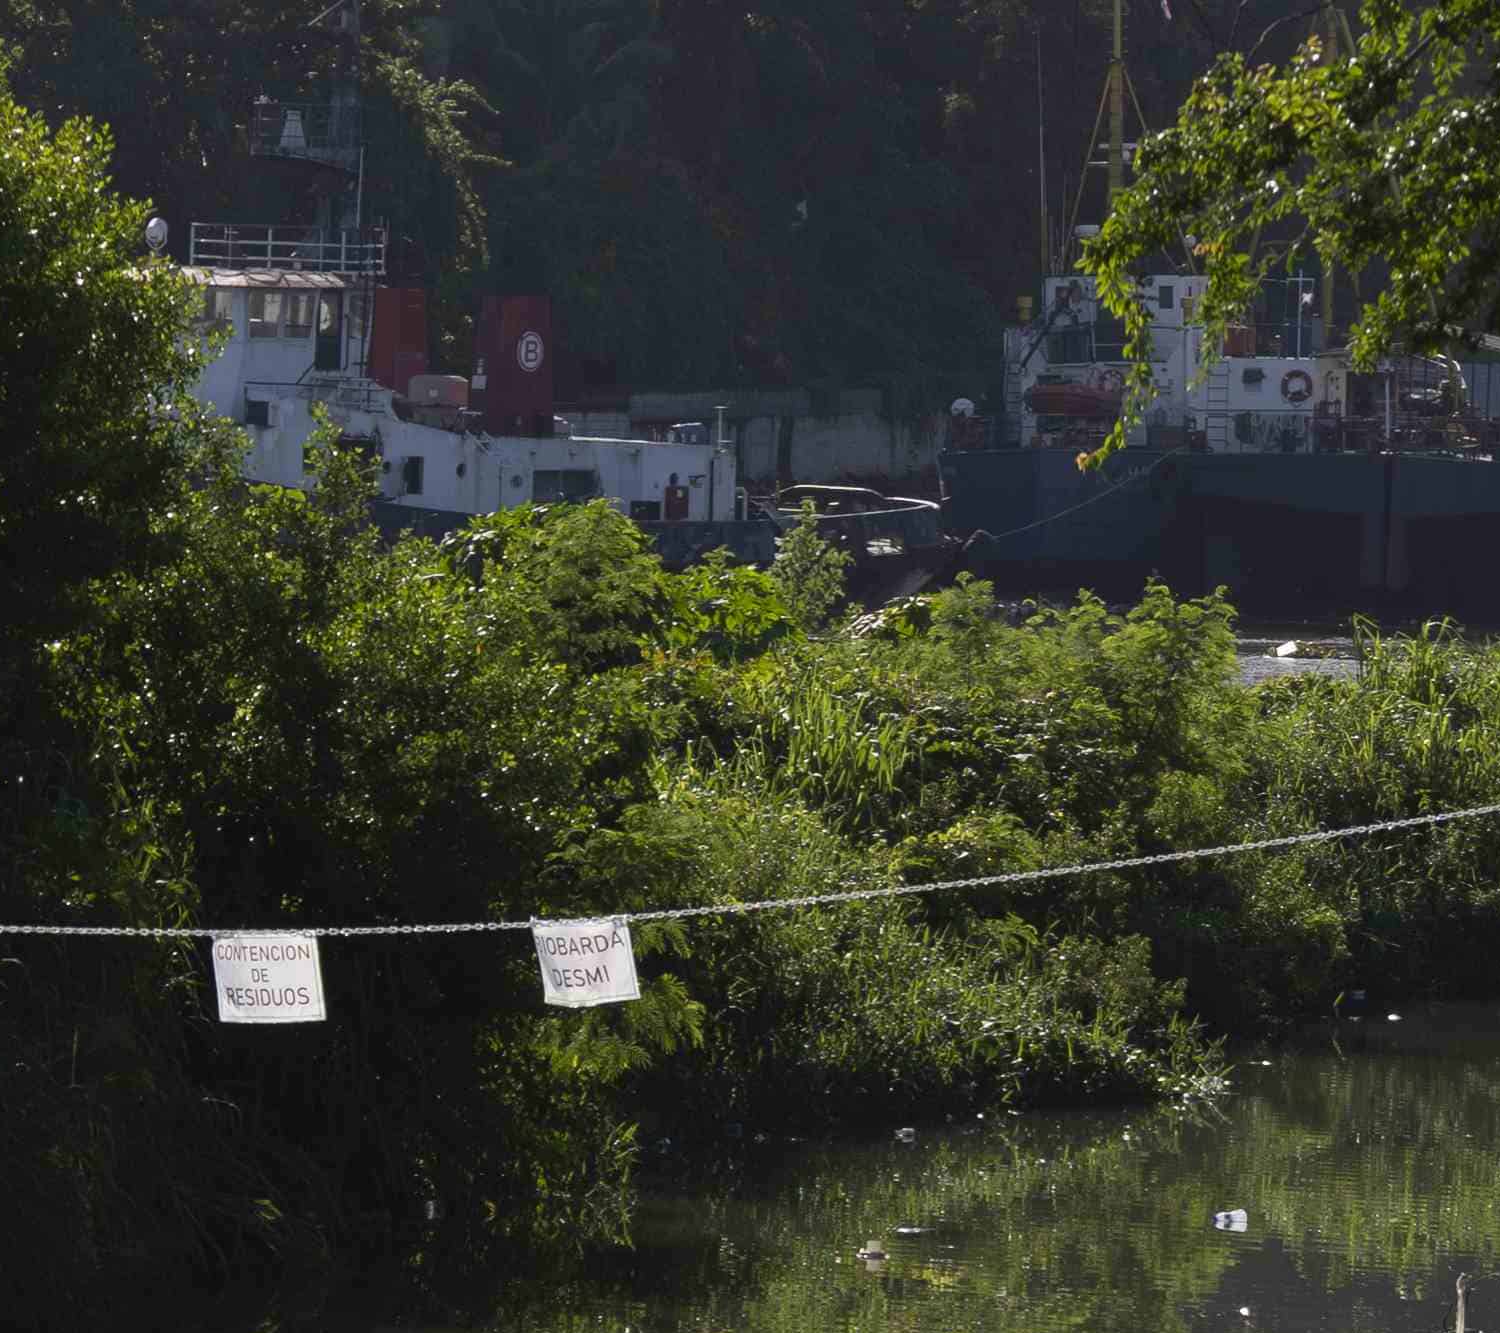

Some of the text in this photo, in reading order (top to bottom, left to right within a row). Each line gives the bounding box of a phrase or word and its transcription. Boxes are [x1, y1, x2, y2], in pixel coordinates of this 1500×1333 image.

[217, 944, 311, 962] CONTENCION
[251, 968, 270, 983] DE
[551, 964, 610, 988] DESMI
[226, 987, 310, 1007] RESIDUOS
